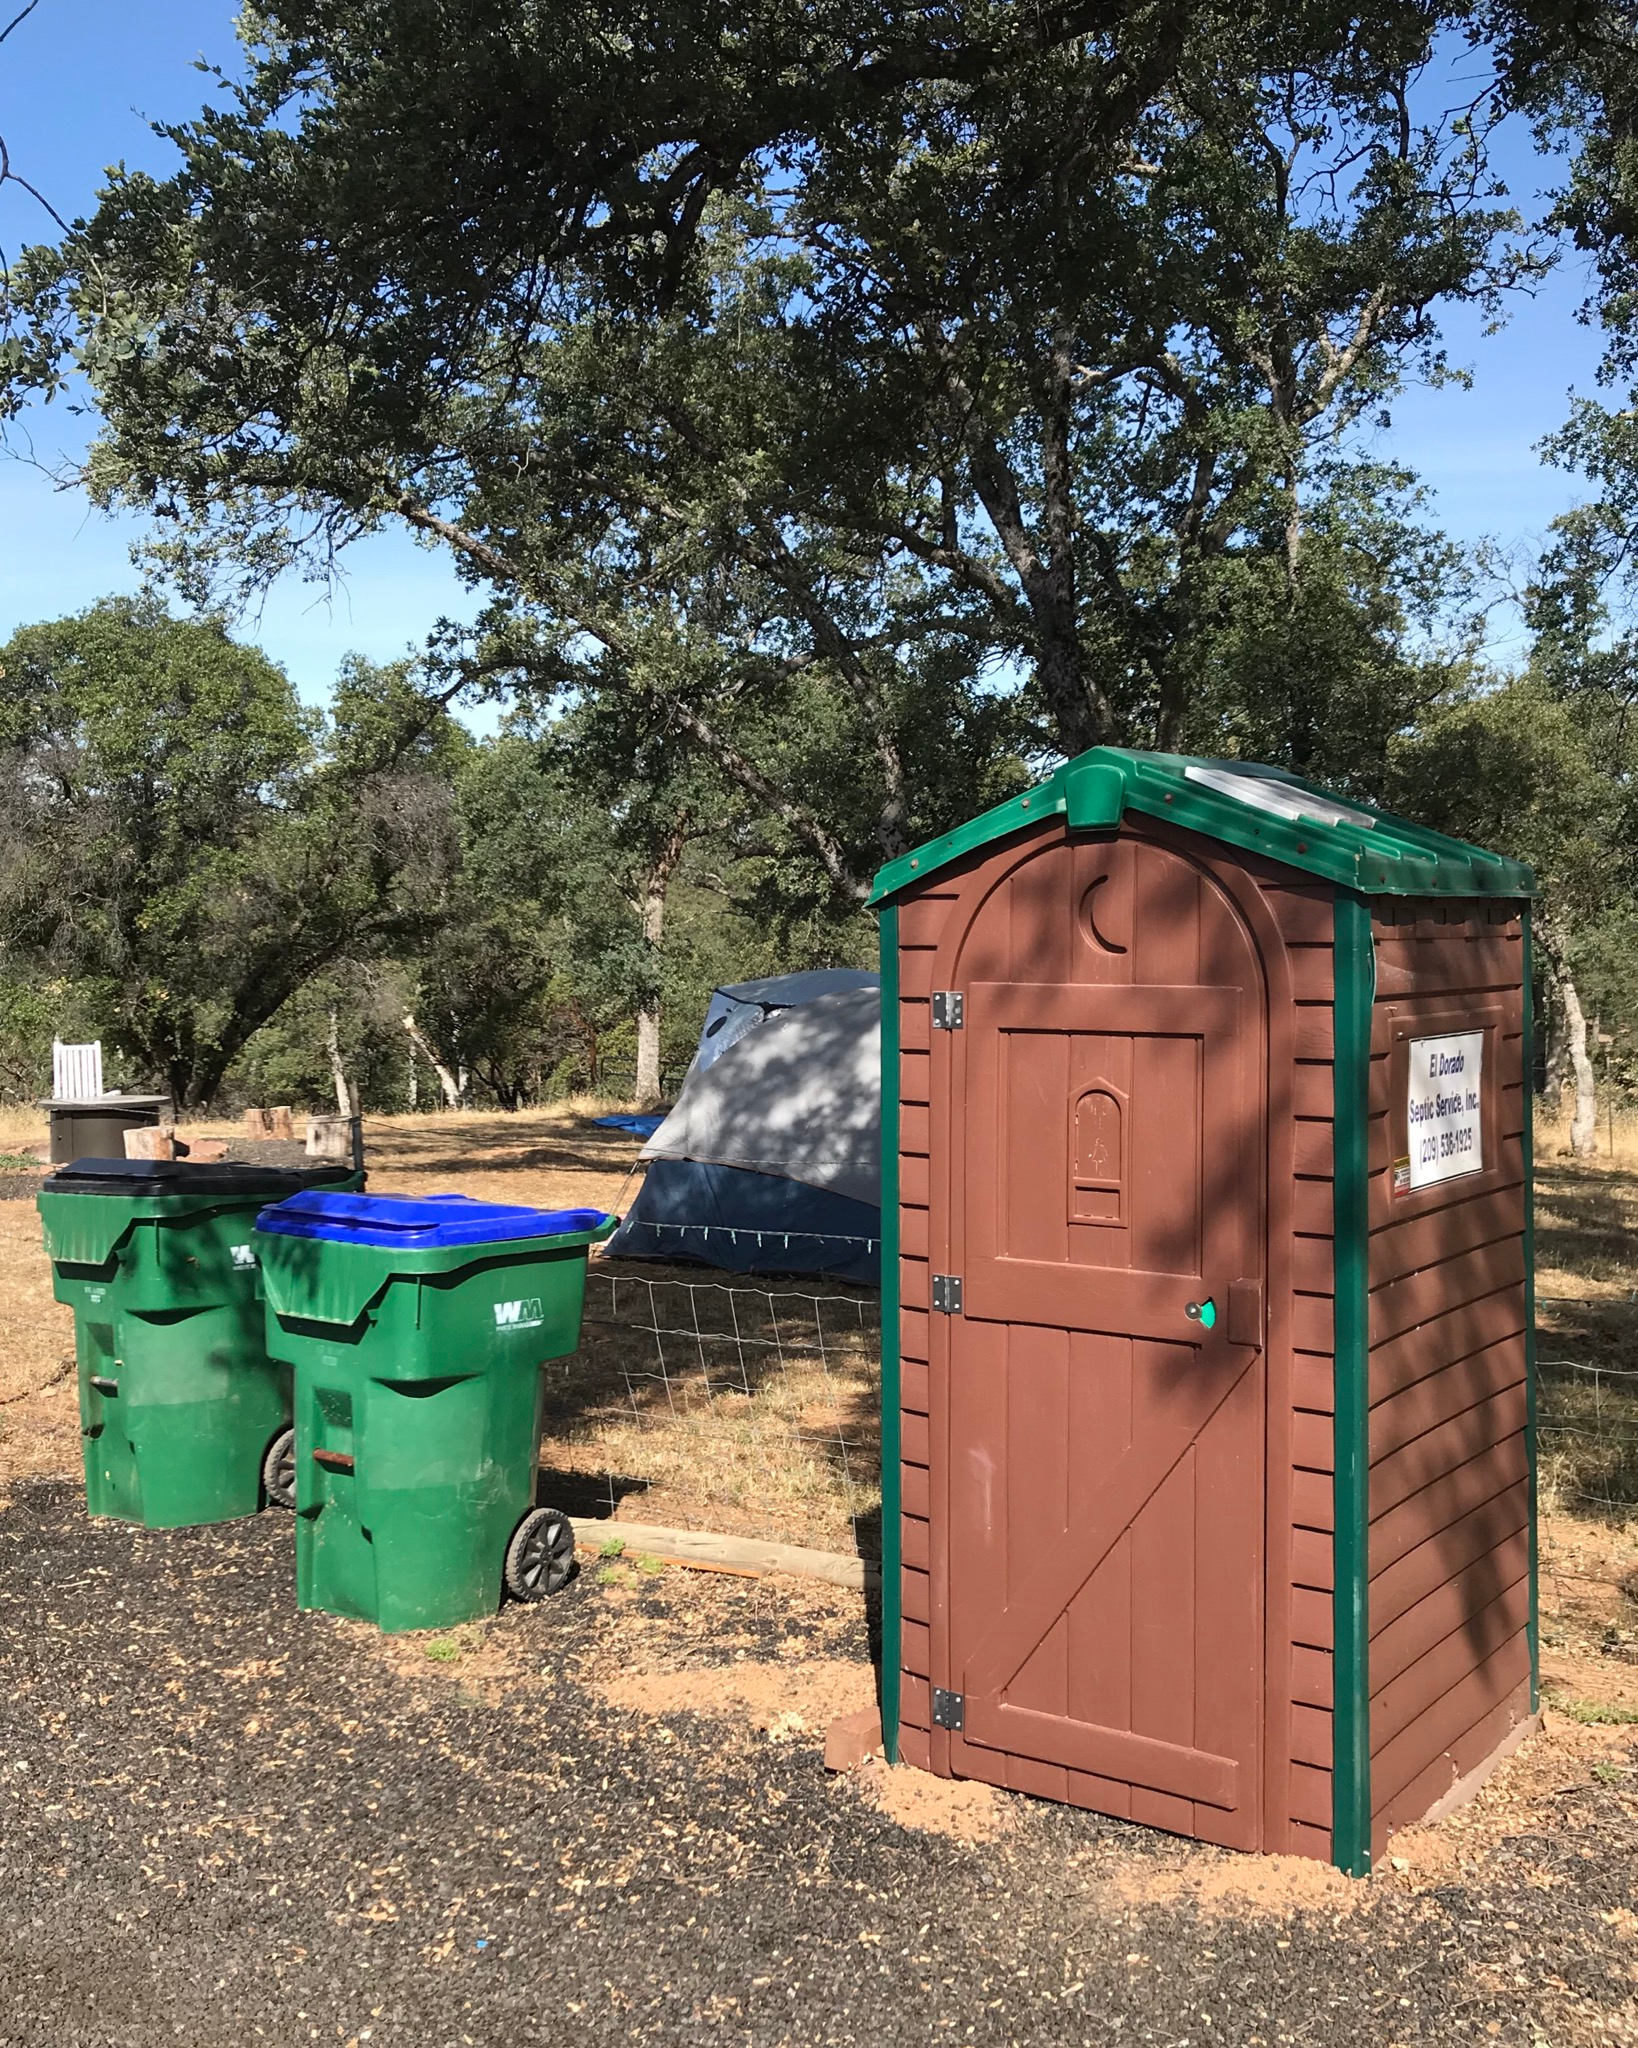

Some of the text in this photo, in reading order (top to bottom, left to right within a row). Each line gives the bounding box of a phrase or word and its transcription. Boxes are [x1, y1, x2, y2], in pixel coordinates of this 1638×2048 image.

[1429, 1050, 1464, 1078] El Dorado
[1410, 1087, 1480, 1127] Septic Service, Inc.
[1420, 1127, 1472, 1169] (209) 536-1925
[493, 1298, 544, 1325] WM
